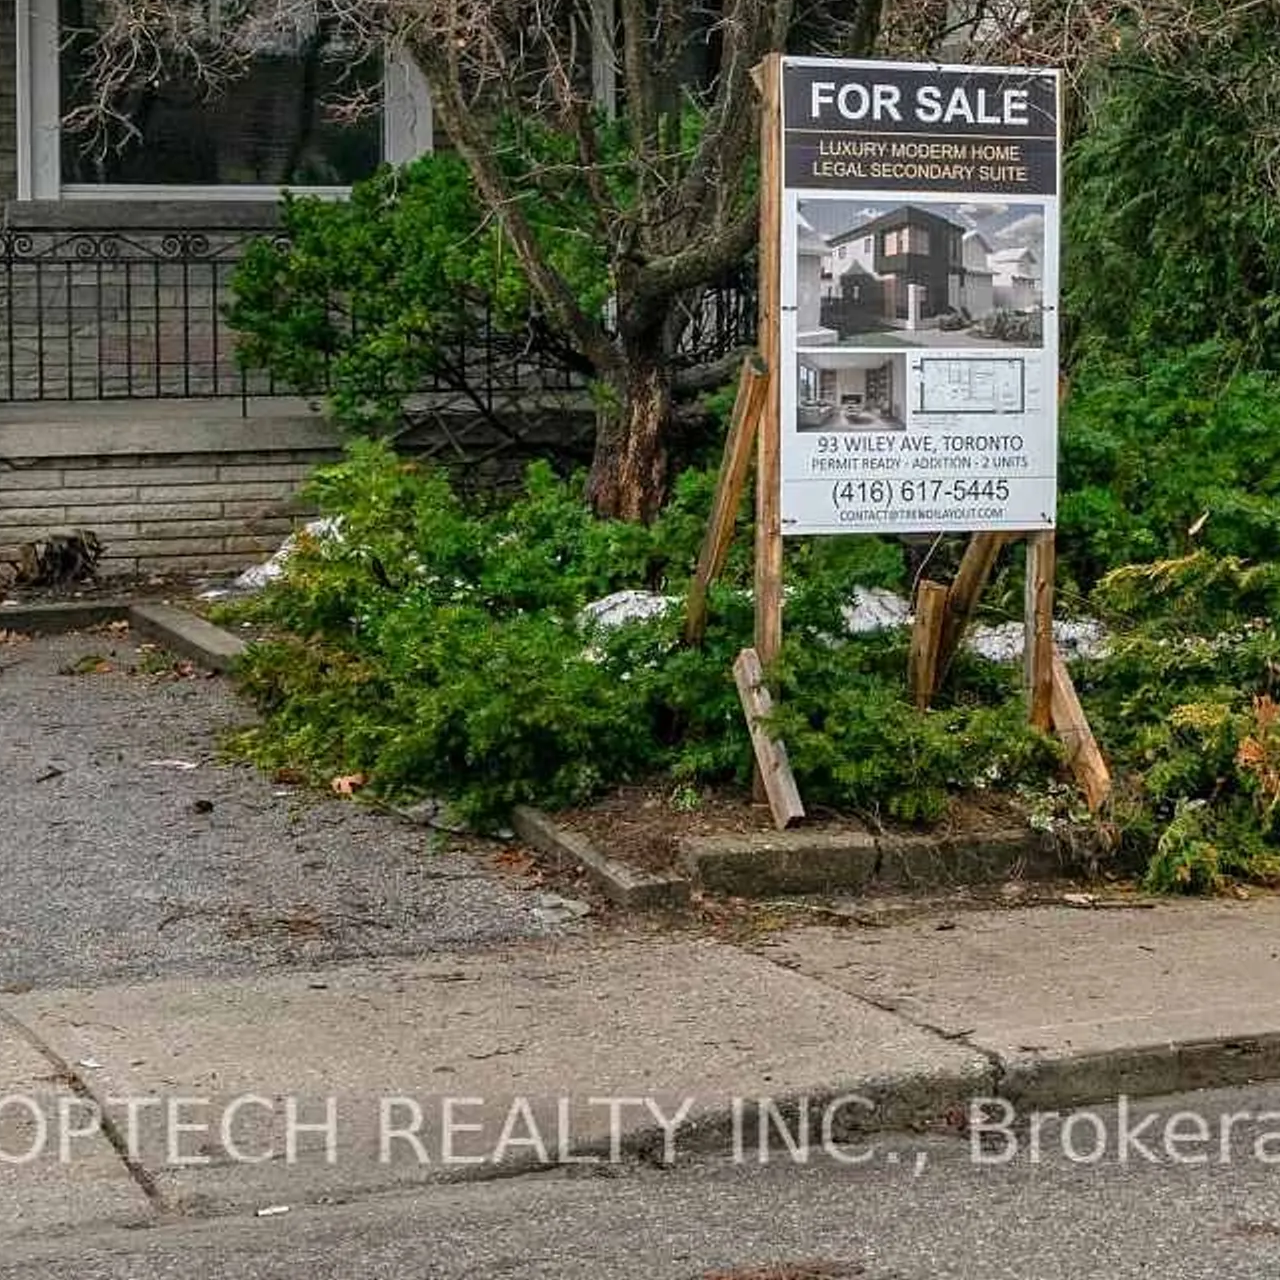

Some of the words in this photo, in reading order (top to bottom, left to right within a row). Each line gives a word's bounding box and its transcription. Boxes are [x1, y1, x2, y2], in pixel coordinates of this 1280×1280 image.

[811, 82, 902, 120] FOR
[915, 86, 1029, 125] SALE
[820, 140, 887, 157] LUXURY
[971, 147, 1021, 162] HOME
[813, 162, 868, 177] LEGAL
[870, 163, 976, 180] SECONDARY
[979, 167, 1028, 181] SUITE
[818, 437, 839, 453] 93
[844, 437, 896, 452] WILEY
[900, 436, 938, 454] AVE,
[943, 436, 1025, 452] TORONTO
[812, 457, 859, 470] PERMIT
[861, 457, 900, 469] READY
[912, 456, 971, 469] ADDITION
[982, 456, 990, 468] 2
[993, 456, 1028, 468] UNITS
[832, 480, 893, 509] (416)
[900, 479, 1010, 502] 617-5445
